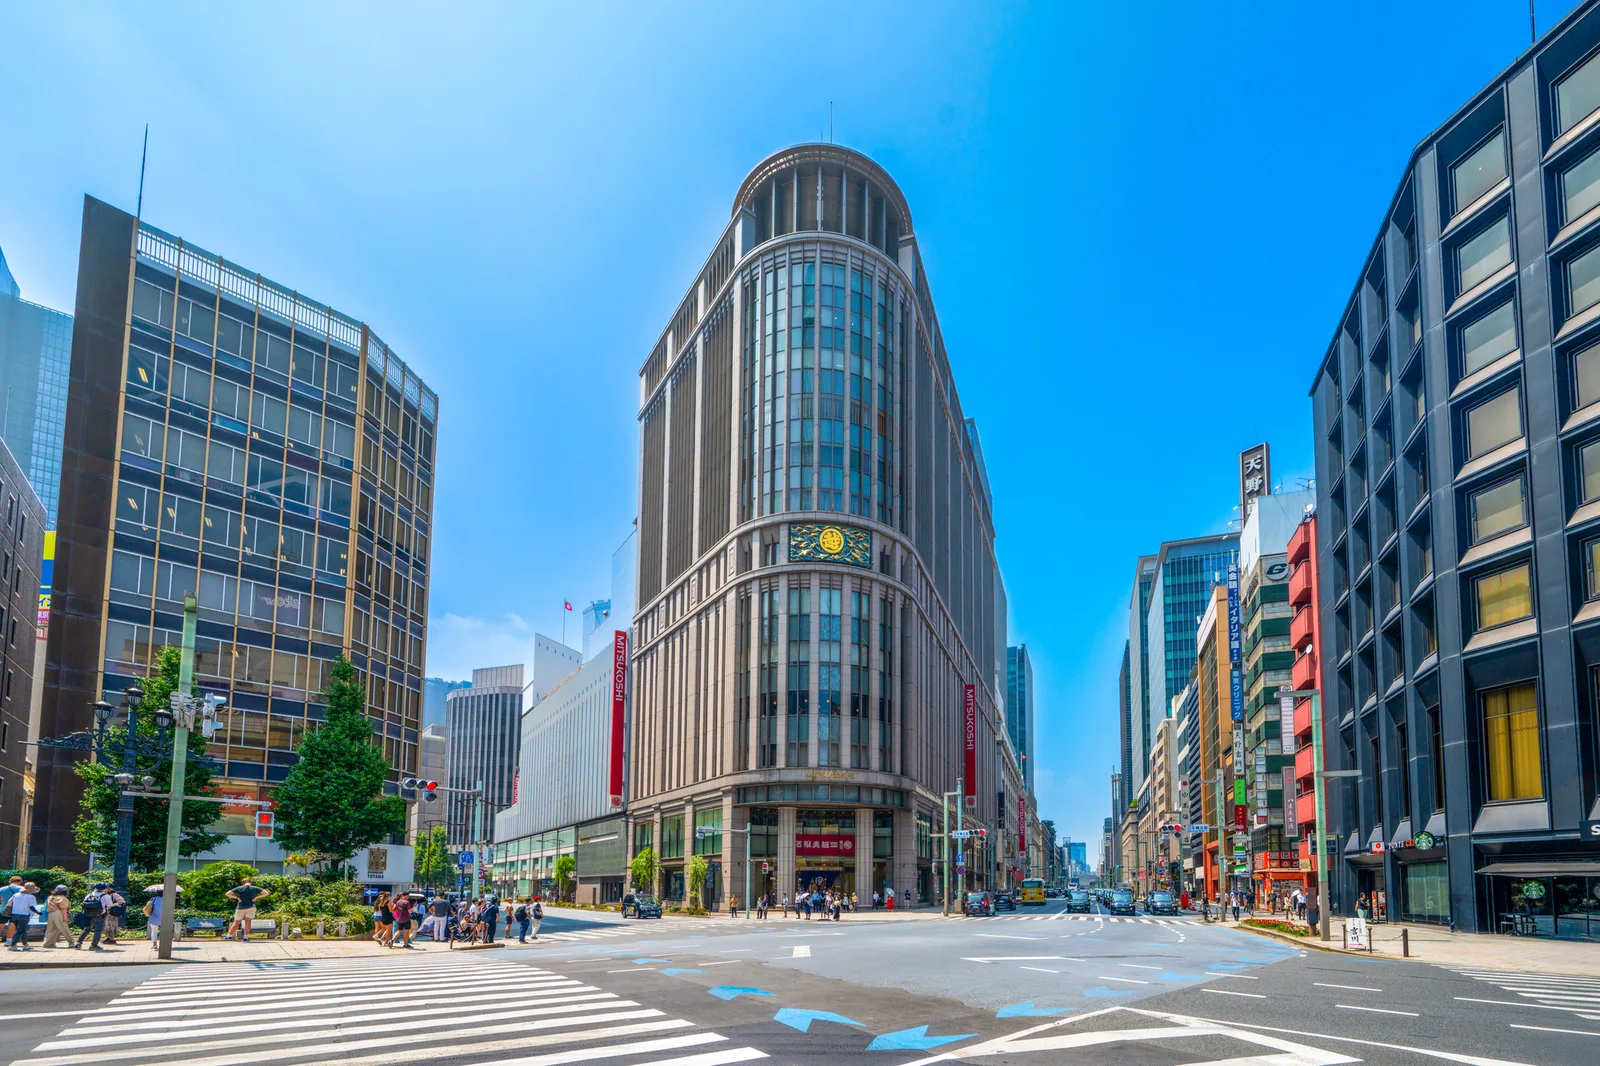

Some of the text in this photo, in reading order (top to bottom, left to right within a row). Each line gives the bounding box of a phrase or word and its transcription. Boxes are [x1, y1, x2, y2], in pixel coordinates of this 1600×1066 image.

[615, 635, 625, 701] MITSUKOSHI
[966, 688, 974, 750] MITSUKOSHI
[805, 771, 855, 779] MITSUKOSHI
[1182, 791, 1190, 843] 山本海店
